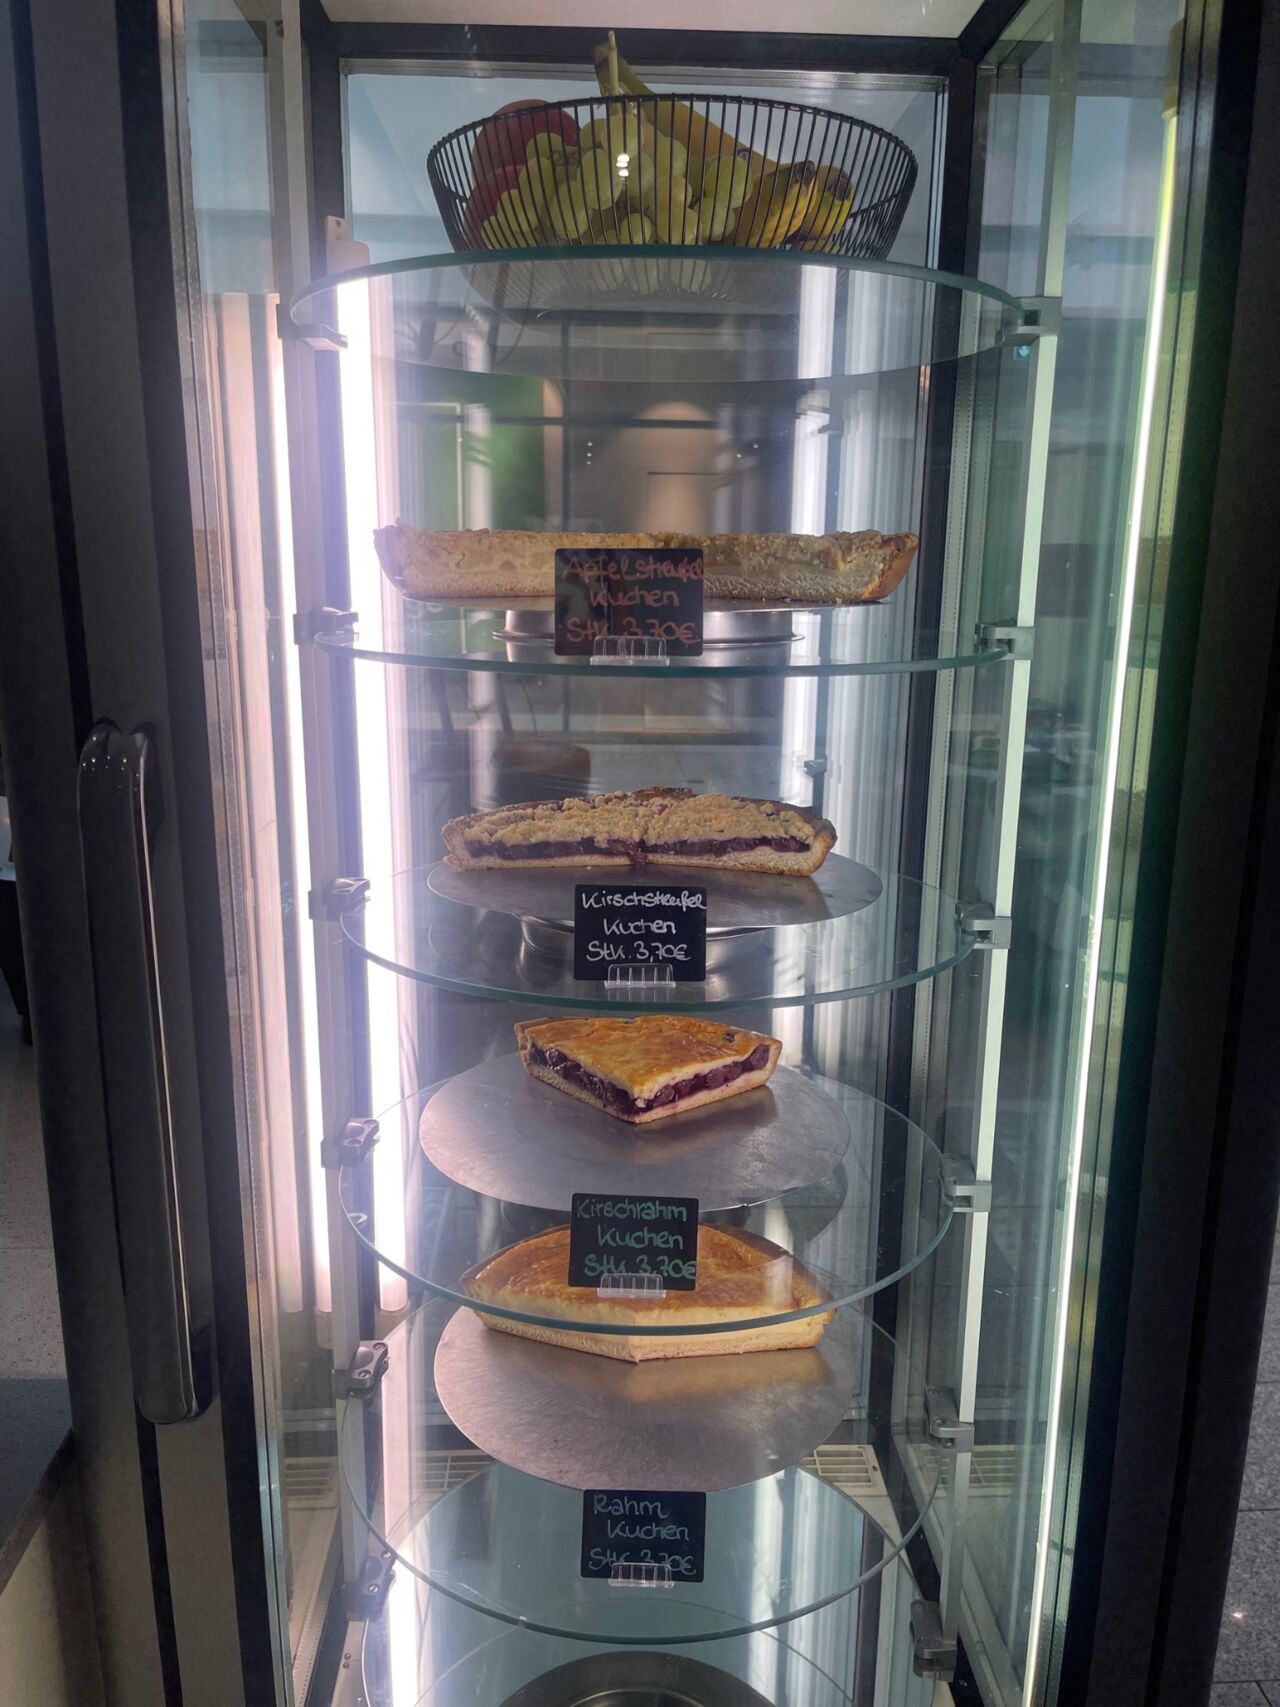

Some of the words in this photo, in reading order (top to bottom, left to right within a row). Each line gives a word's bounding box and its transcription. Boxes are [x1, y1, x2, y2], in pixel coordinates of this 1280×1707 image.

[590, 585, 680, 607] Kuchen
[623, 616, 702, 643] 370€
[603, 918, 676, 935] Kuchen
[586, 940, 632, 961] Stk.
[634, 941, 691, 963] 3,70€
[577, 1198, 687, 1222] Kirschrahm
[597, 1224, 684, 1250] Kuchen
[593, 1494, 668, 1518] Rahm
[607, 1519, 690, 1541] Kuchen
[640, 1548, 697, 1575] 370€
